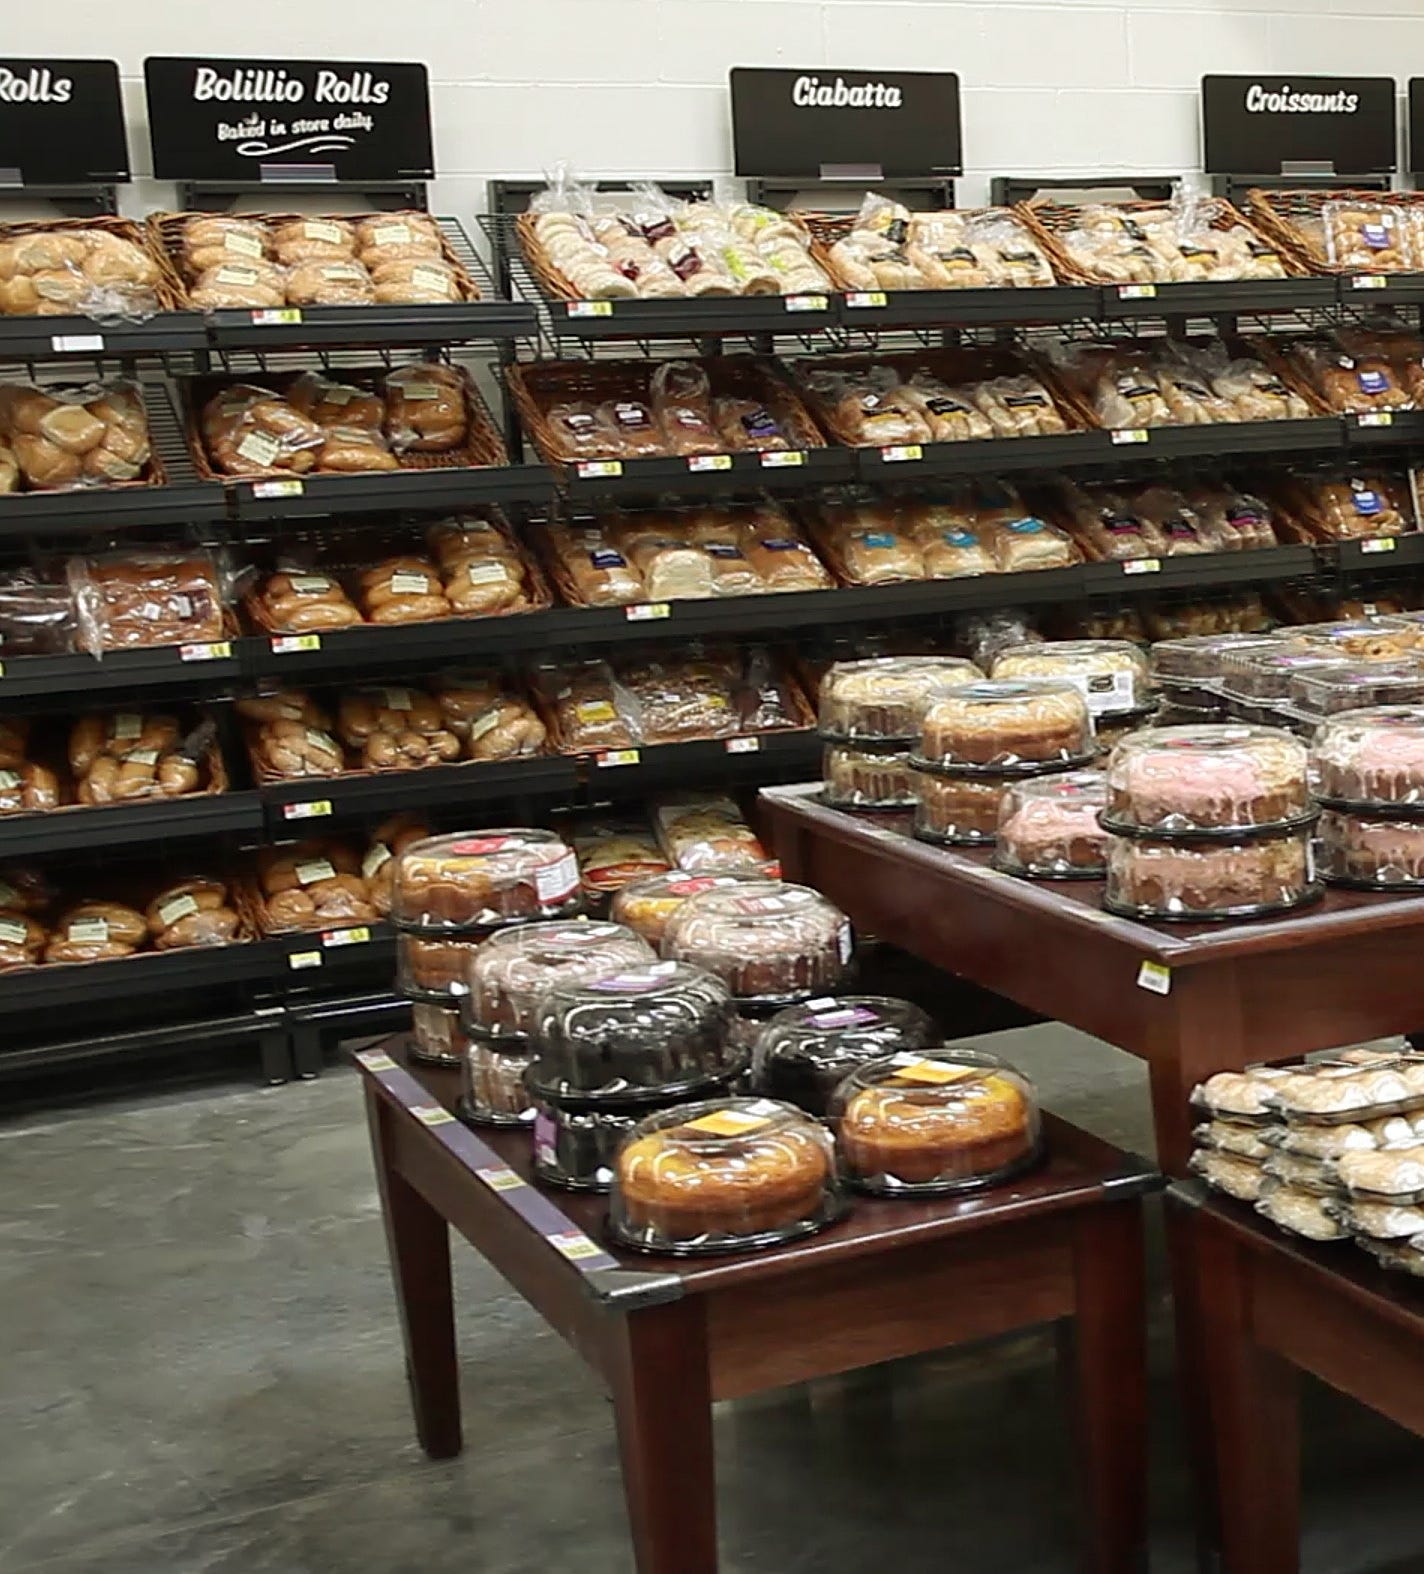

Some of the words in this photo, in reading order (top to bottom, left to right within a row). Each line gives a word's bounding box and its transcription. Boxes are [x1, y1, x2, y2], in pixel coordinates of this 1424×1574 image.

[0, 67, 72, 102] Rolls
[194, 67, 304, 101] Bolillio
[314, 71, 390, 103] Rolls
[793, 76, 902, 107] Ciabatta
[1246, 84, 1359, 112] Croissants
[217, 118, 266, 141] Baked
[270, 119, 287, 135] in
[291, 118, 330, 134] store
[333, 111, 374, 132] daily
